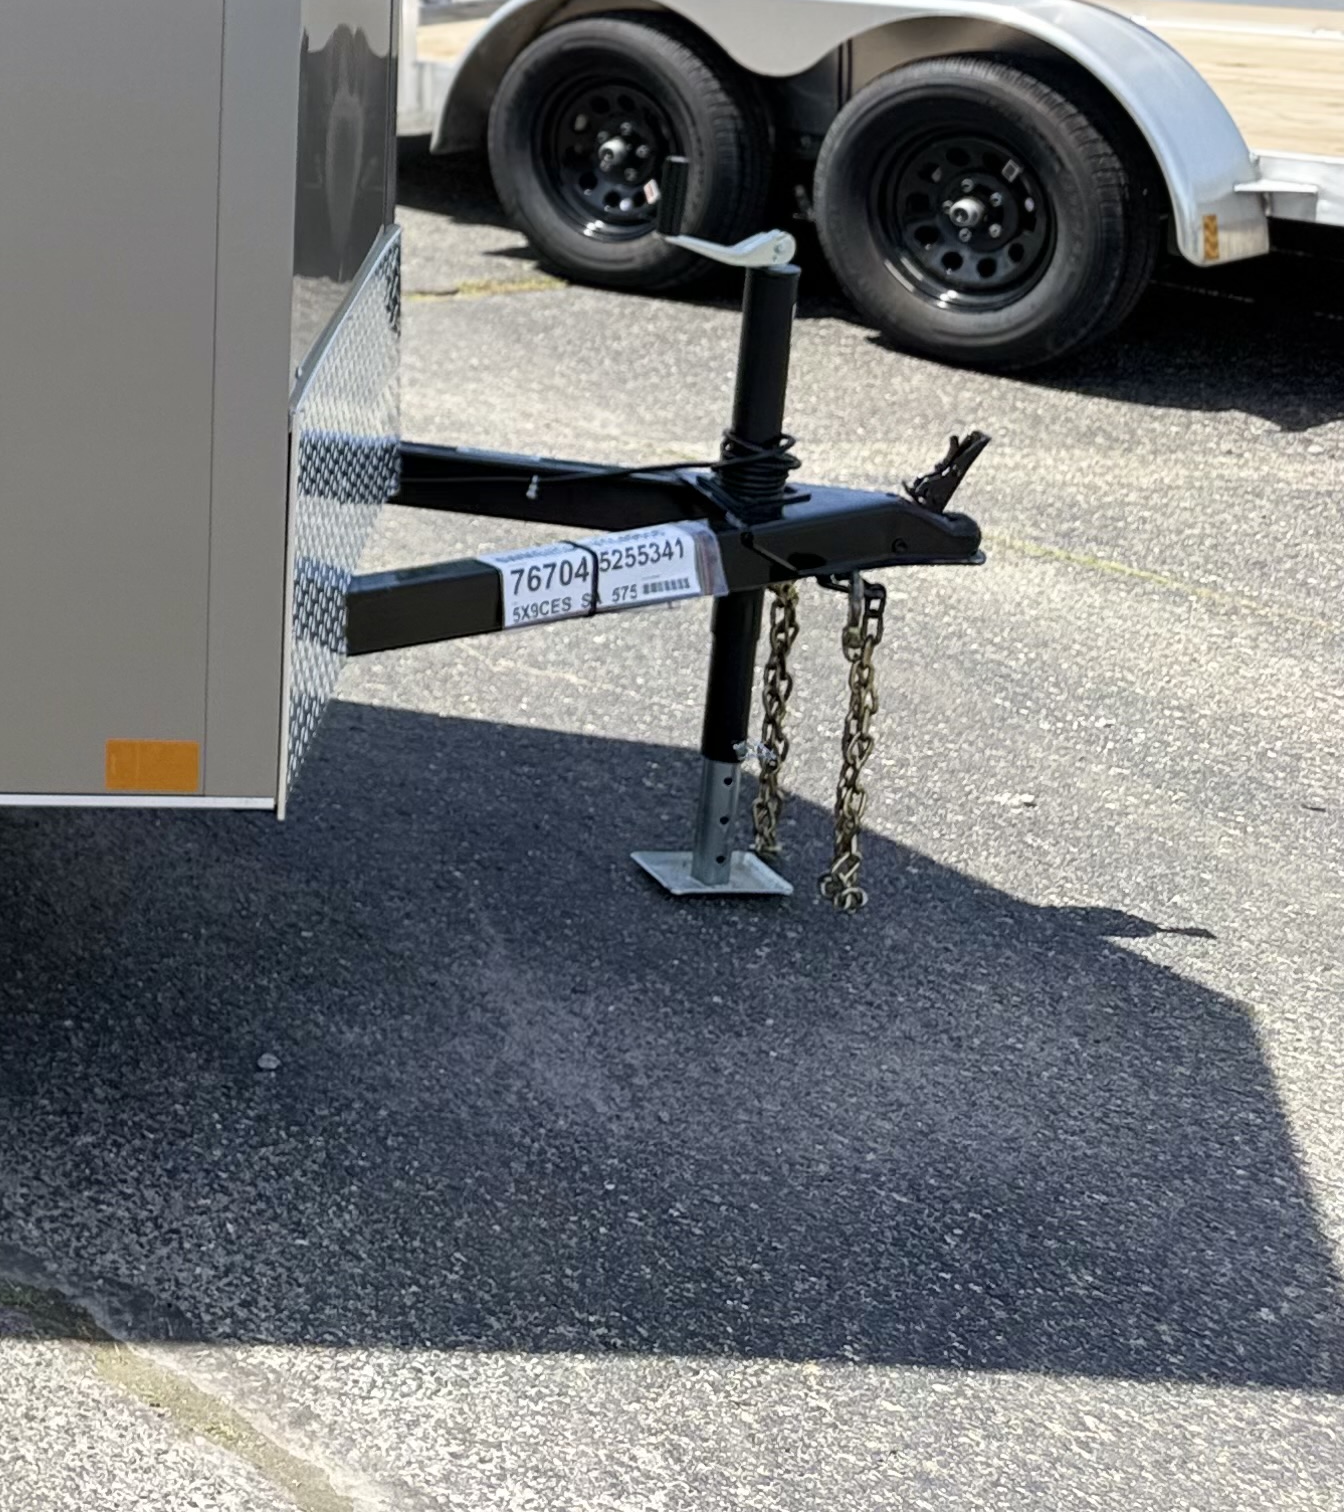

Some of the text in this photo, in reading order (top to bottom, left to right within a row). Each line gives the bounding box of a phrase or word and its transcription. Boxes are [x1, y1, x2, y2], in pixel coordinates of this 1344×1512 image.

[510, 556, 590, 596] 76704
[599, 537, 684, 572] 5255341
[512, 596, 572, 624] 5X9CES
[612, 583, 638, 603] 575
